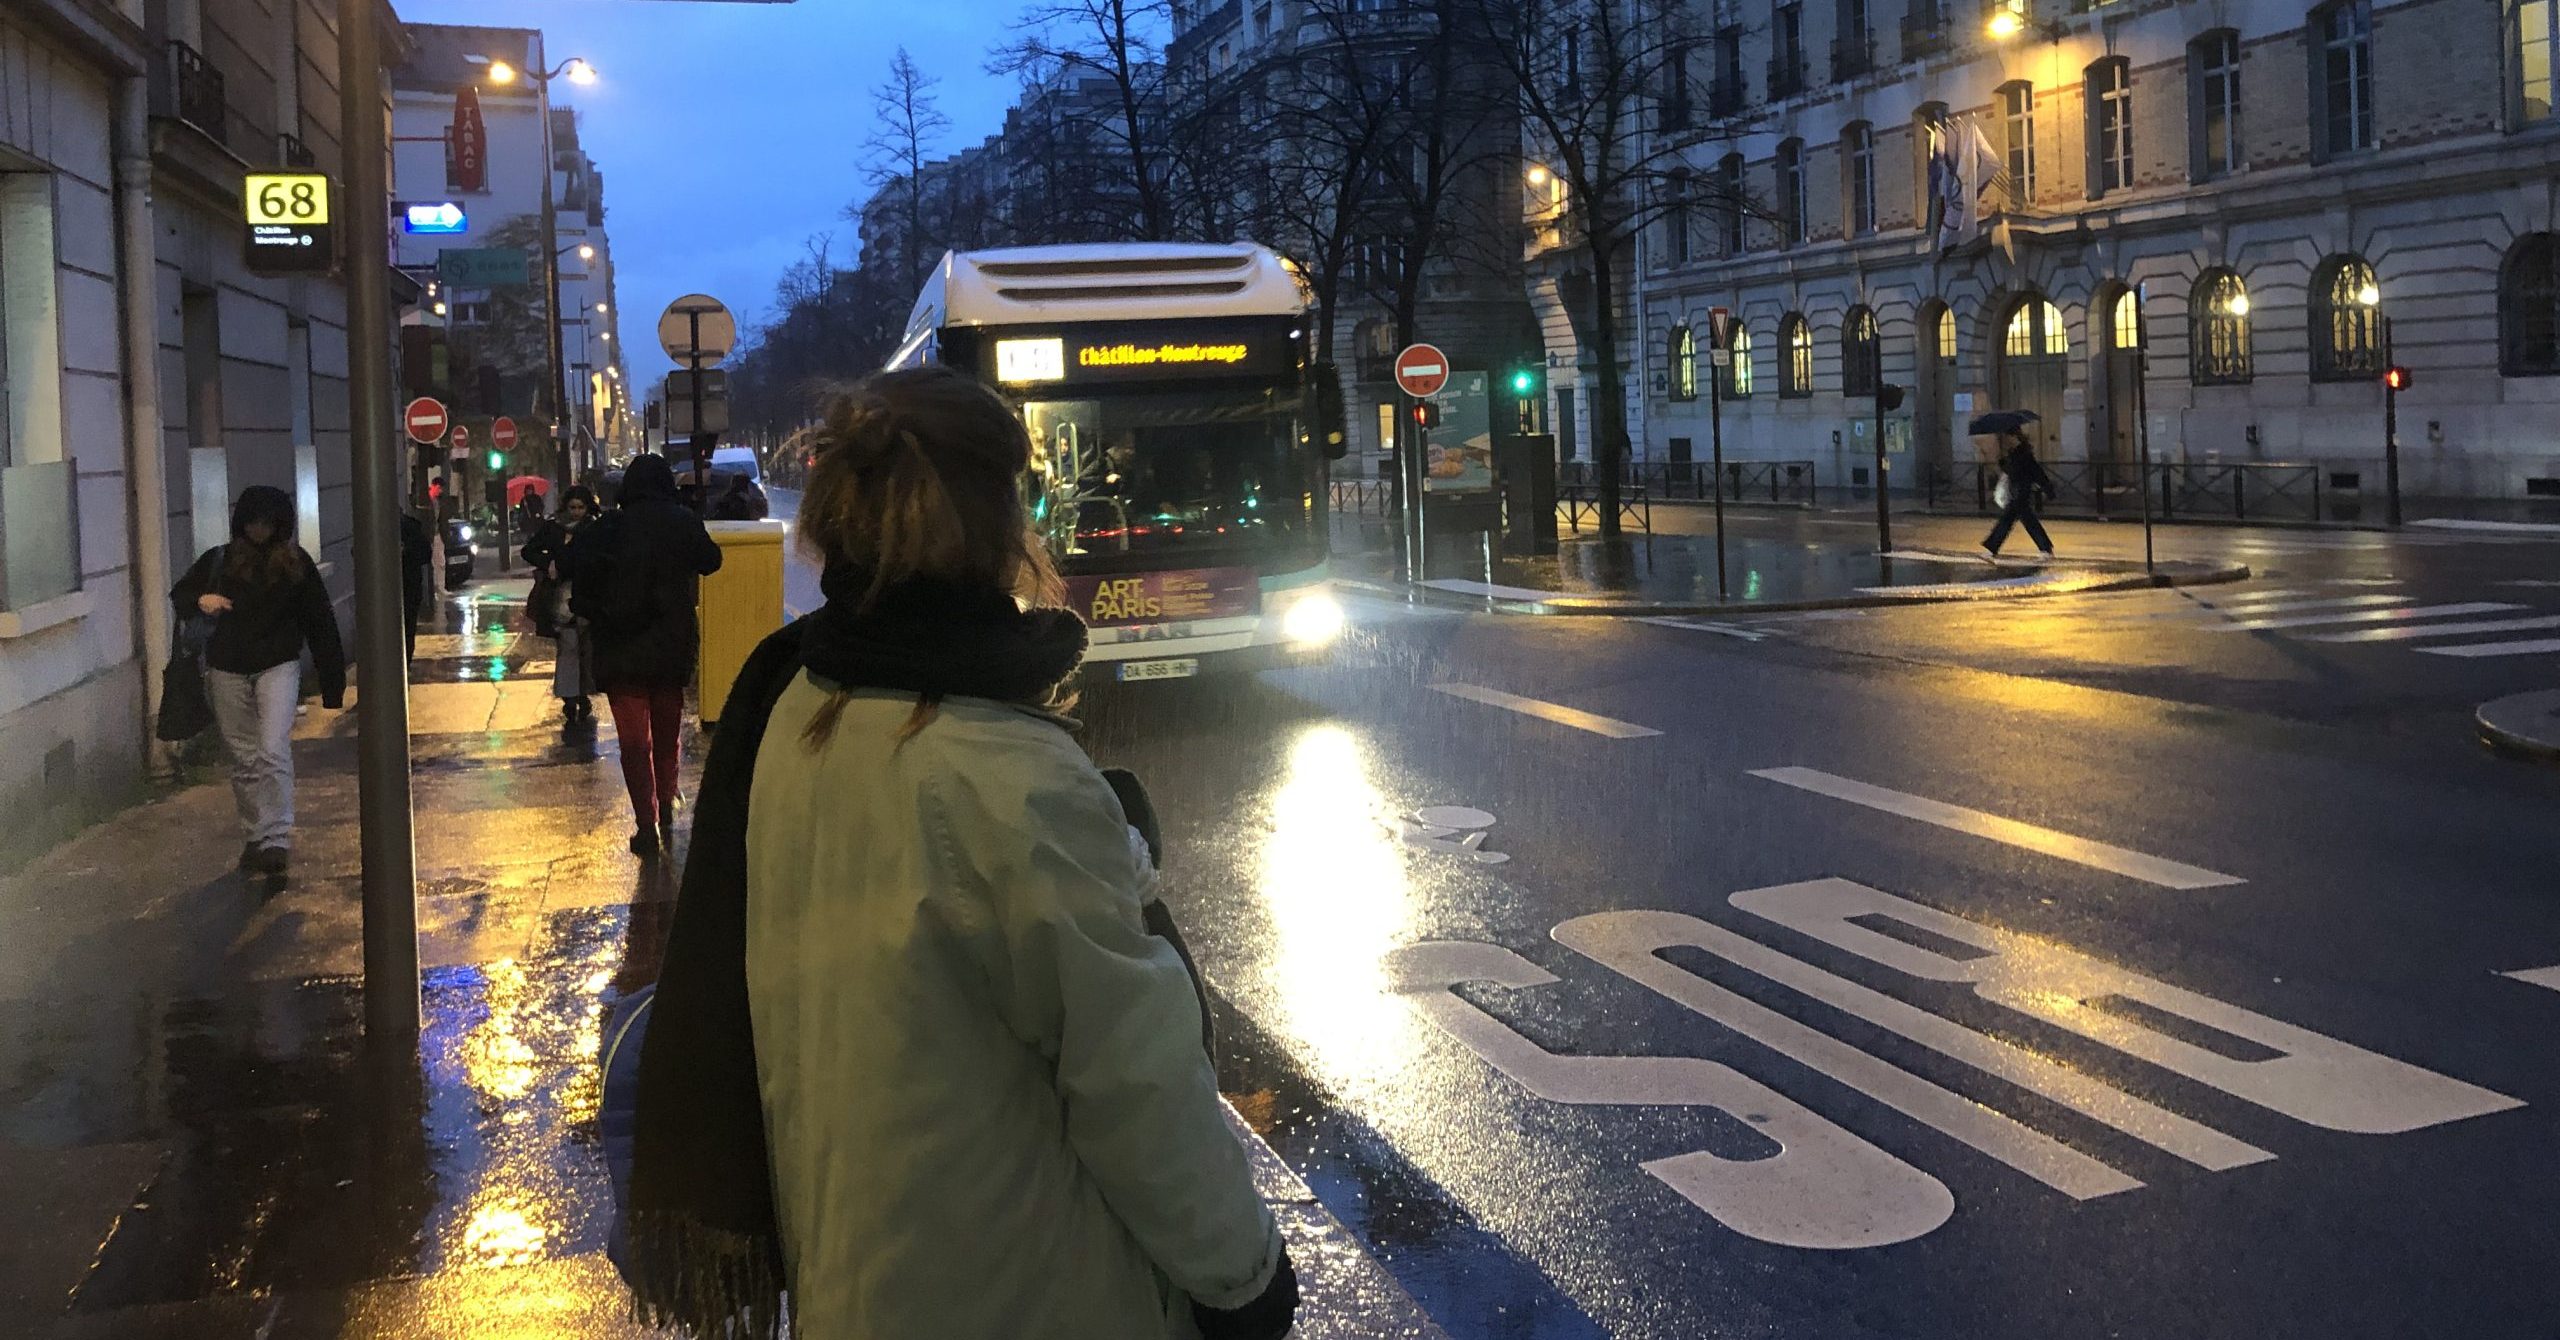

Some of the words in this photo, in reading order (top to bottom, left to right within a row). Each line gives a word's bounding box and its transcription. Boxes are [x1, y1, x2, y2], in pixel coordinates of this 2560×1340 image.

[463, 107, 474, 169] TABAC
[259, 182, 317, 219] 68
[1095, 578, 1145, 601] ART
[1091, 597, 1161, 621] PARIS
[1385, 877, 2529, 1248] BUS
